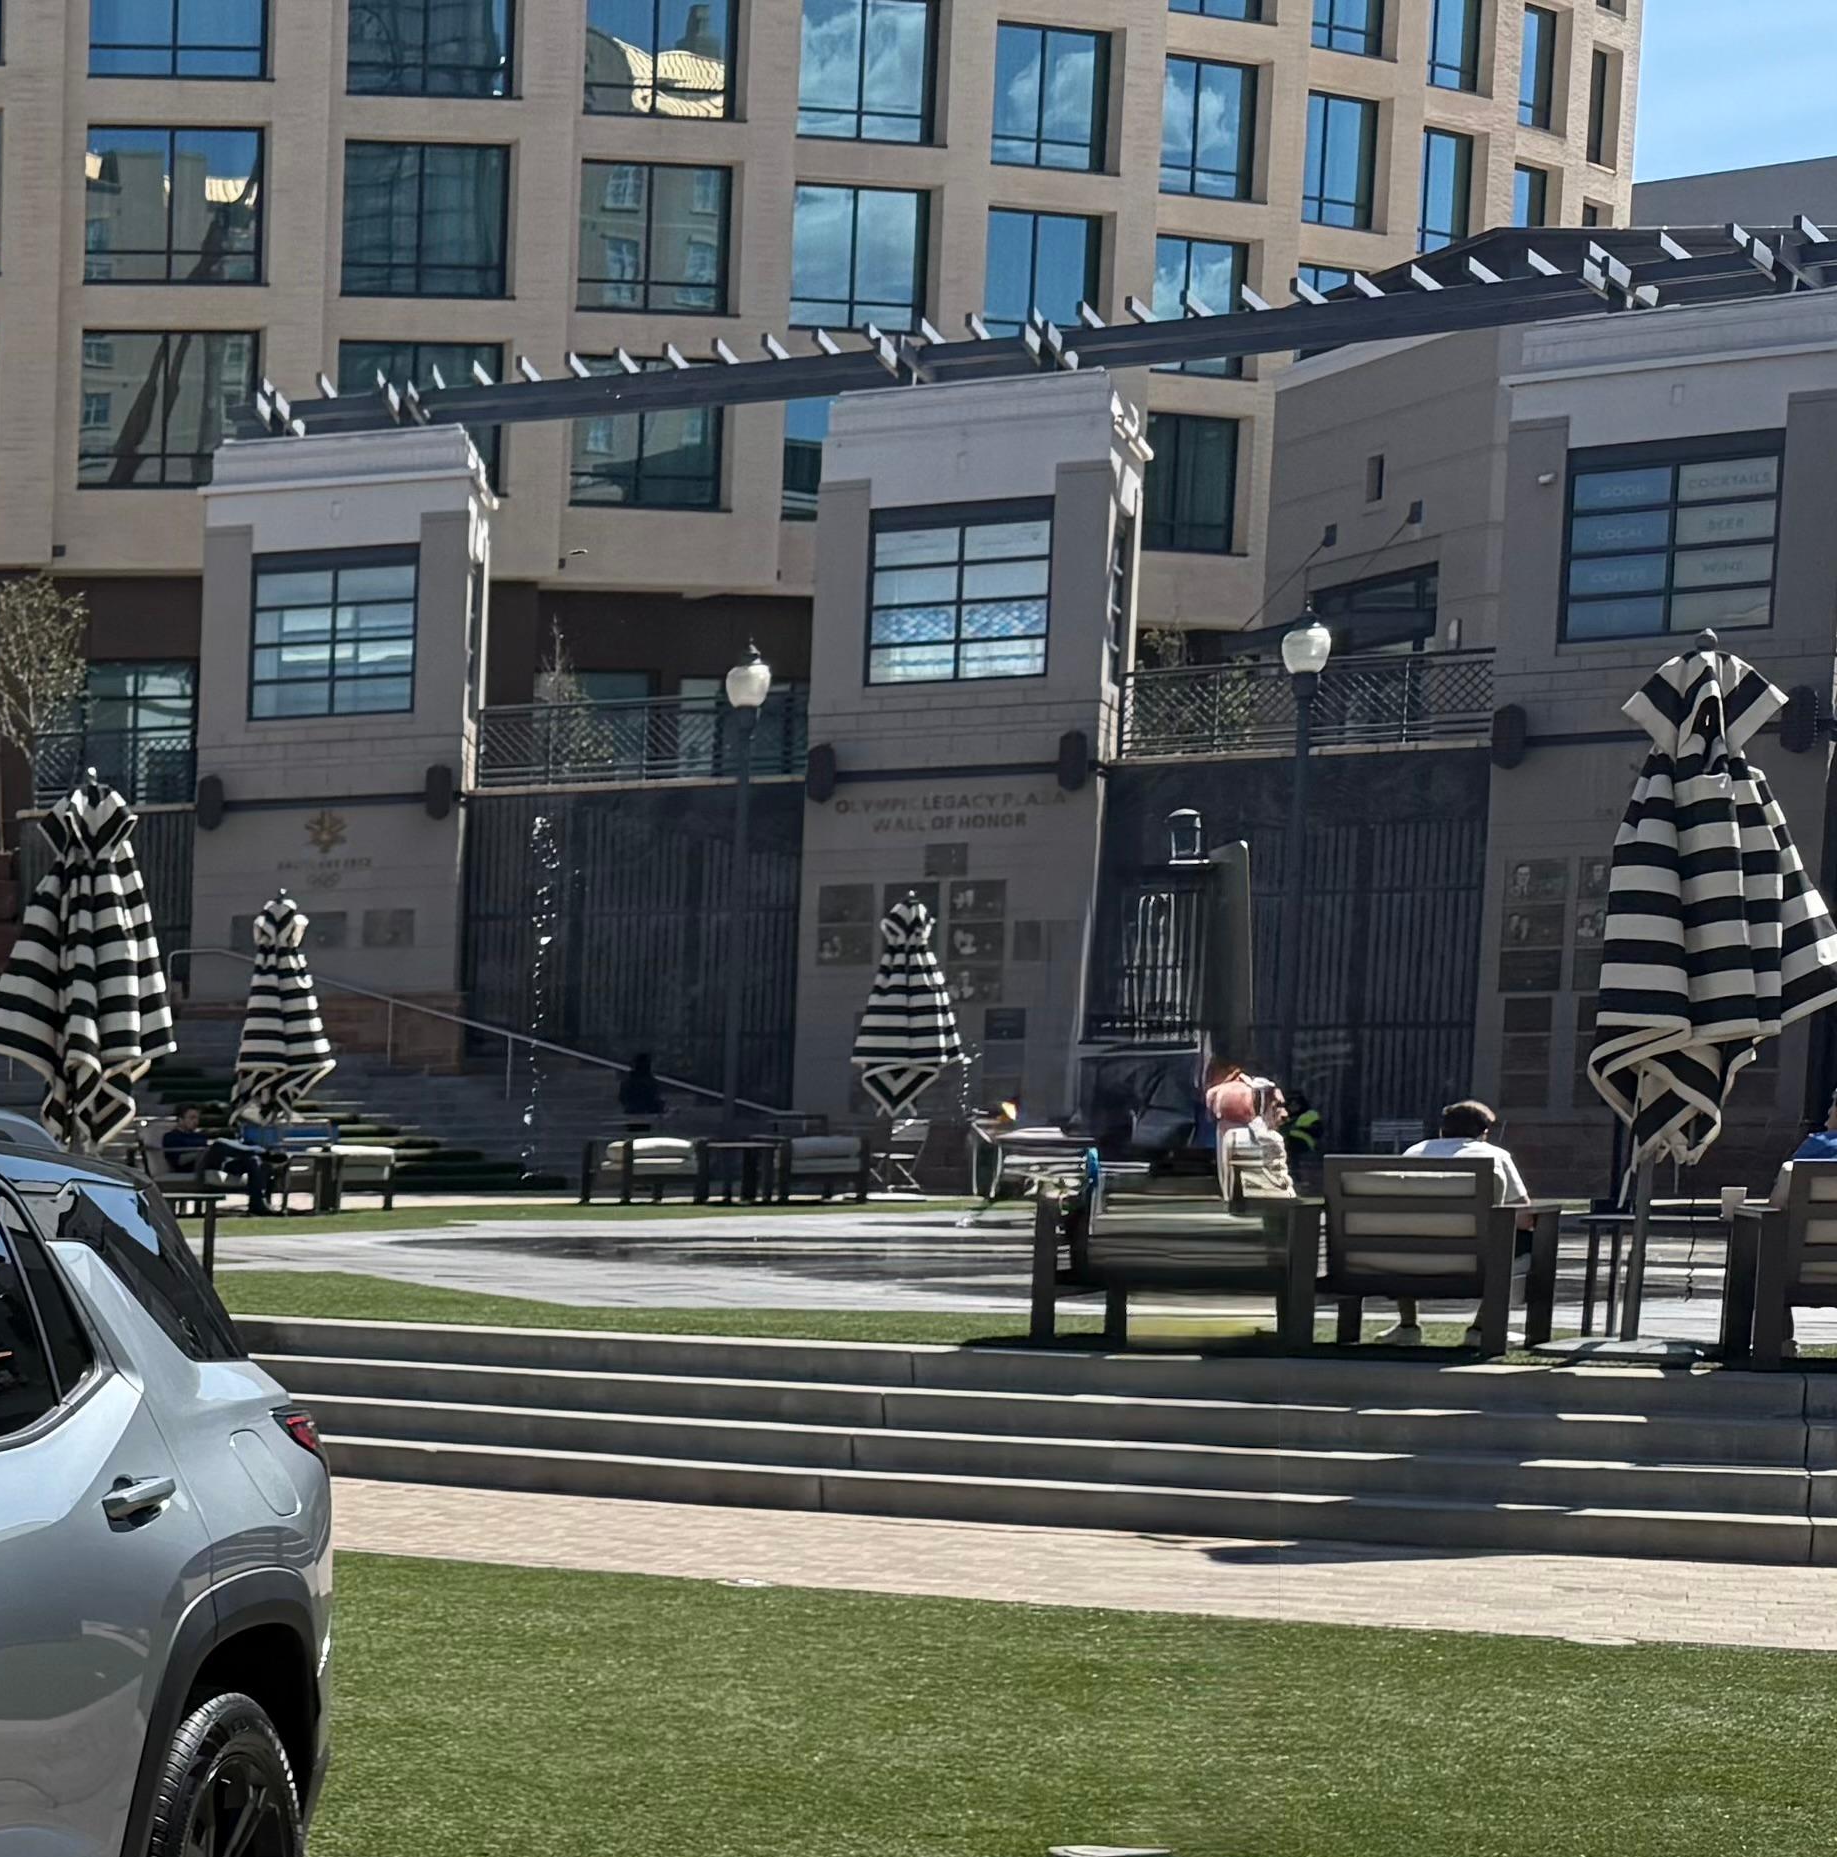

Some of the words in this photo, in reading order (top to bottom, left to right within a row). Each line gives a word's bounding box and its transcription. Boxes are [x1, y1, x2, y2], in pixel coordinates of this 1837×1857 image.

[922, 794, 996, 811] LEGACY
[872, 816, 926, 833] WALL
[931, 815, 957, 831] OF
[958, 812, 1028, 830] HONOR
